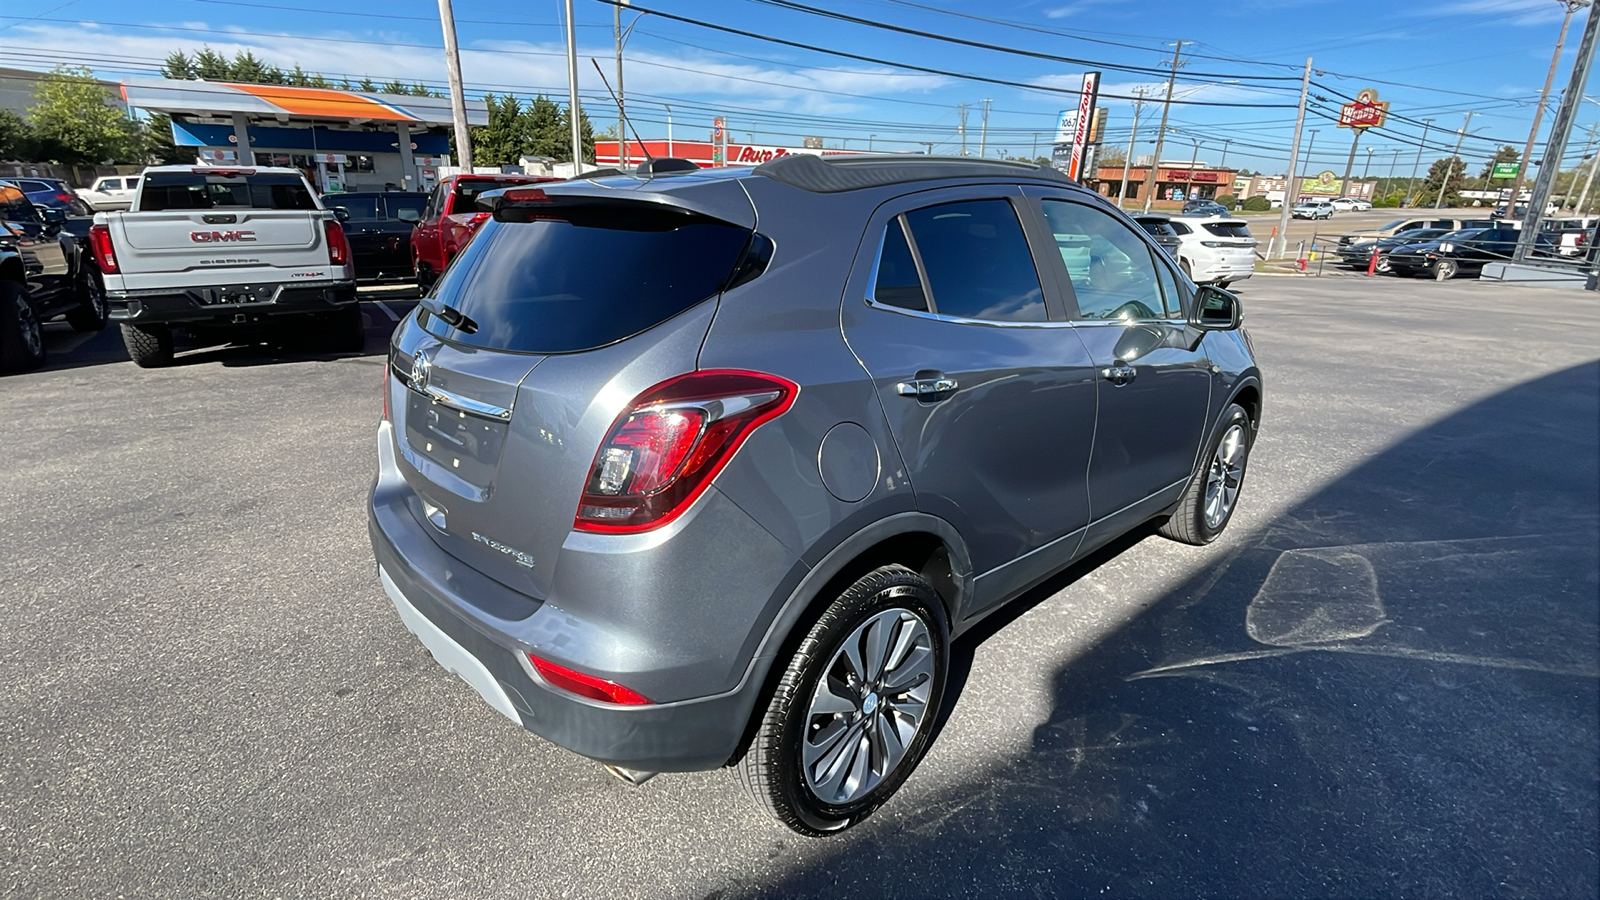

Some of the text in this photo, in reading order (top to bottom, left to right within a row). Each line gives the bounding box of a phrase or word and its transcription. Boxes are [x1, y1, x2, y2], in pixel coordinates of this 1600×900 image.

[1075, 80, 1093, 147] AutoZone
[1341, 105, 1382, 123] Wendy's
[740, 146, 799, 163] AutoZ
[190, 230, 257, 243] GMC
